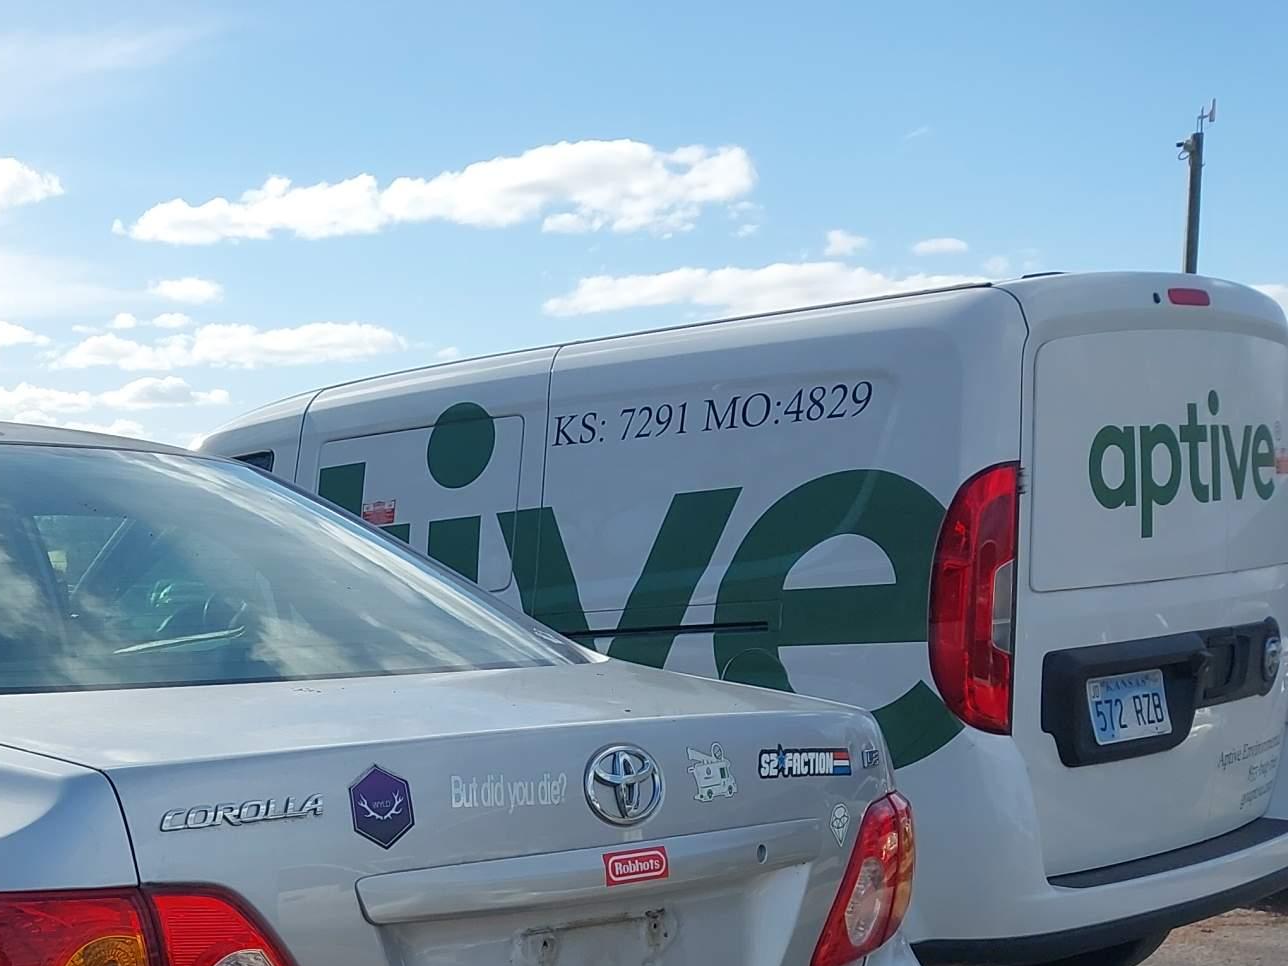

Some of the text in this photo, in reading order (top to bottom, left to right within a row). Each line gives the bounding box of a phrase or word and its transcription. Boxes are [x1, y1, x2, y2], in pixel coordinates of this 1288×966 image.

[552, 380, 874, 447] KS: 7291 MO:4829
[1089, 390, 1275, 538] aptive
[1095, 692, 1165, 732] 572 RZB
[784, 751, 833, 775] FACTION
[160, 793, 324, 832] COROLLA
[450, 772, 567, 814] But did you die?
[614, 859, 661, 876] Robhots
